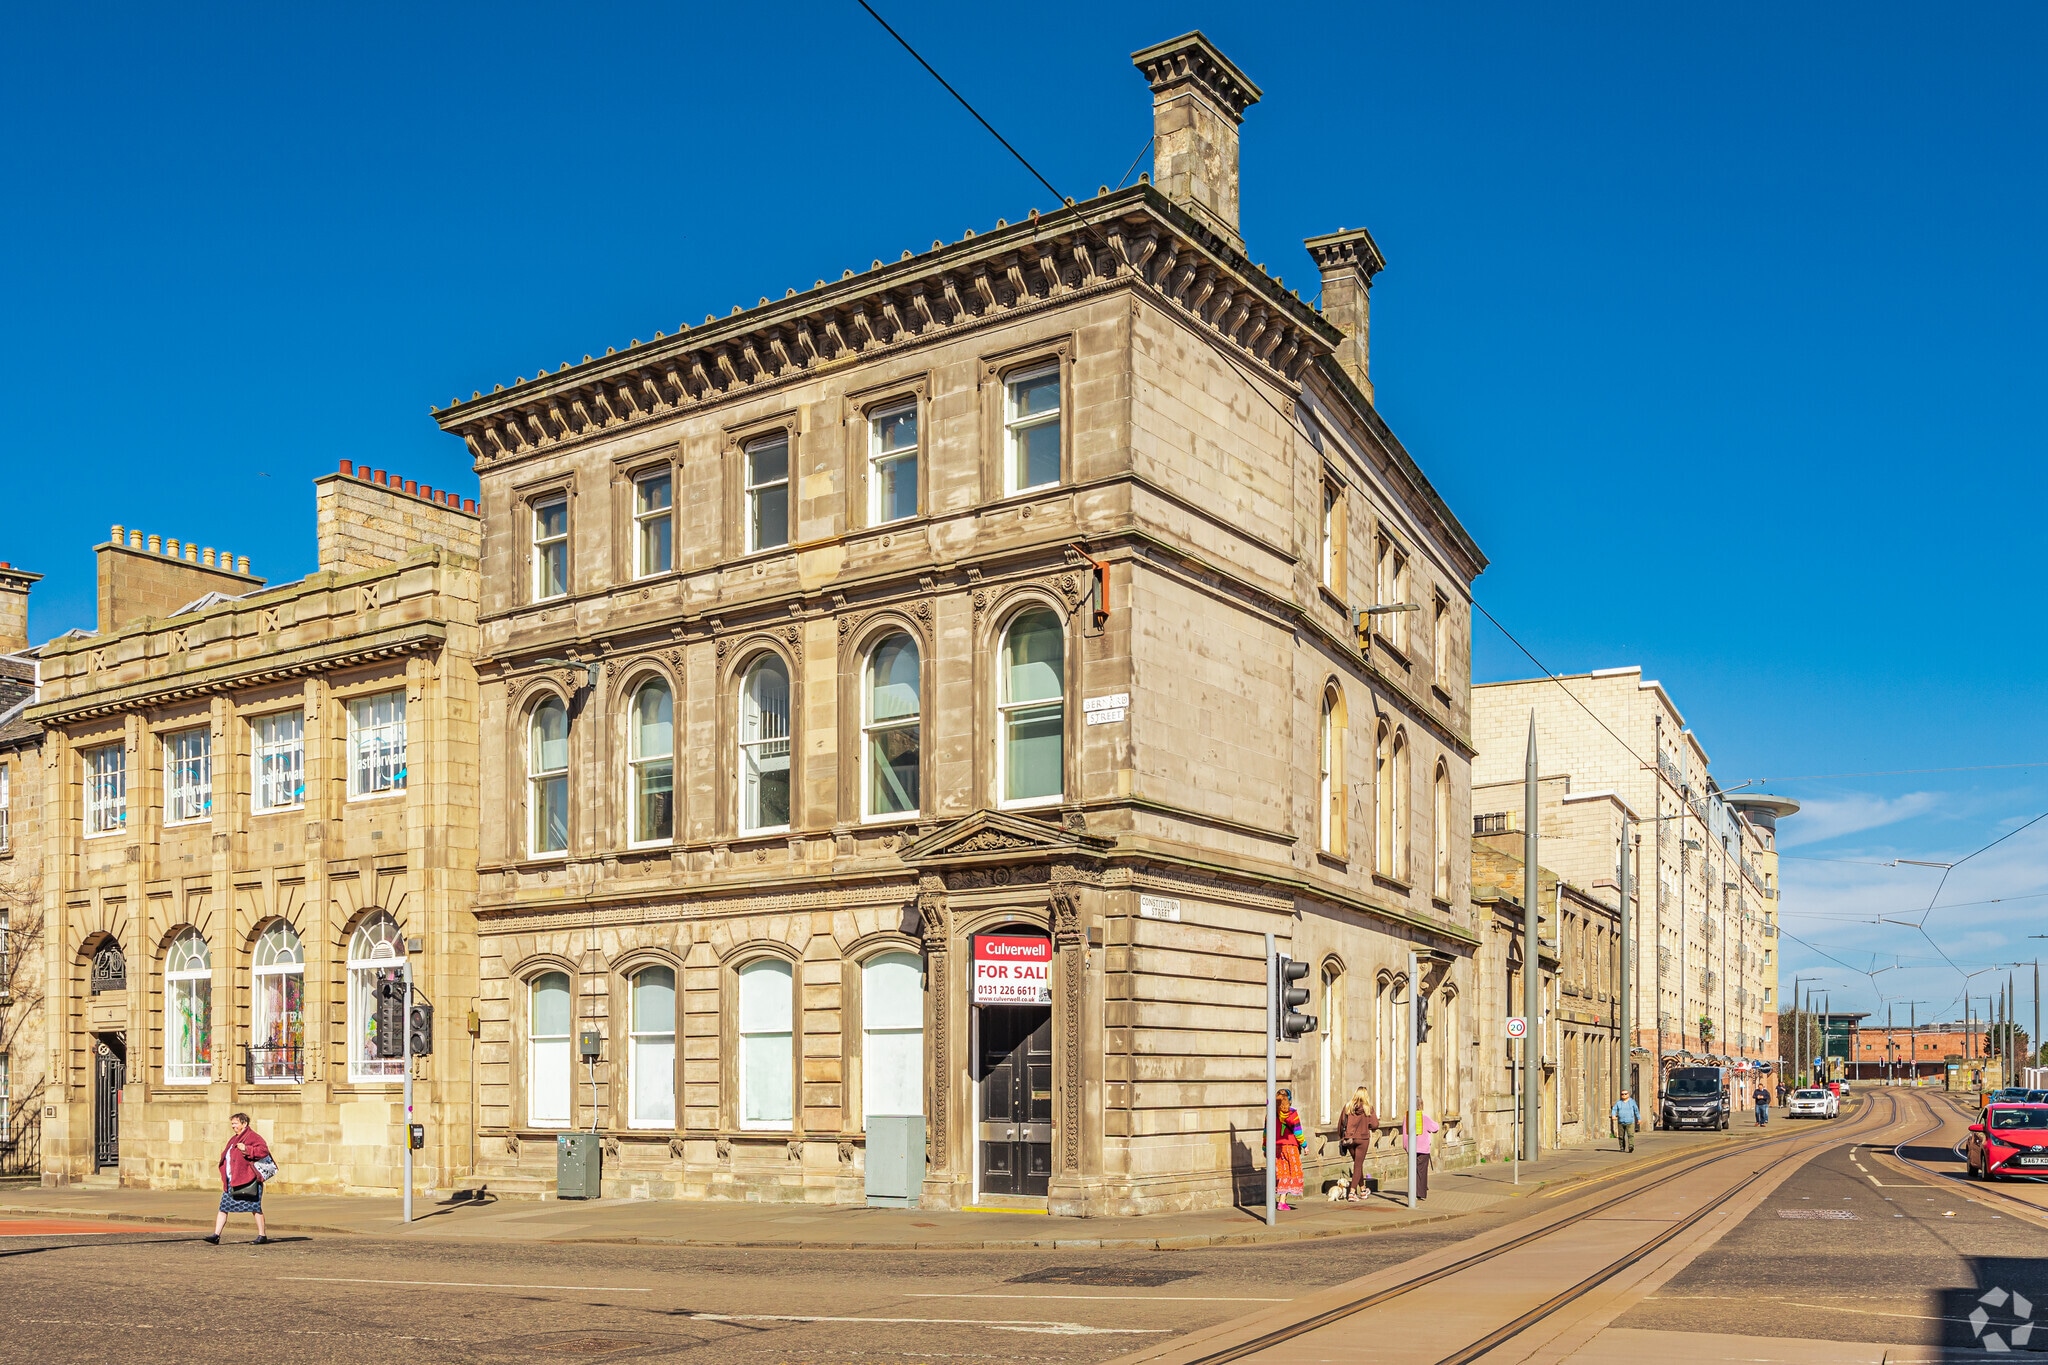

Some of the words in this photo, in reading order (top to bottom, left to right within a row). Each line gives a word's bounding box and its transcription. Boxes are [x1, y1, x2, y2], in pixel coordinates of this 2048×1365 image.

[1085, 696, 1127, 709] BERNARD
[1090, 710, 1121, 722] STREET
[1142, 897, 1179, 910] CONSTITUTION
[1152, 907, 1171, 918] STREET
[985, 942, 1046, 956] Culverwell
[978, 965, 1008, 979] FOR
[978, 985, 997, 995] 0131
[1000, 986, 1015, 995] 226
[1017, 986, 1037, 996] 6611
